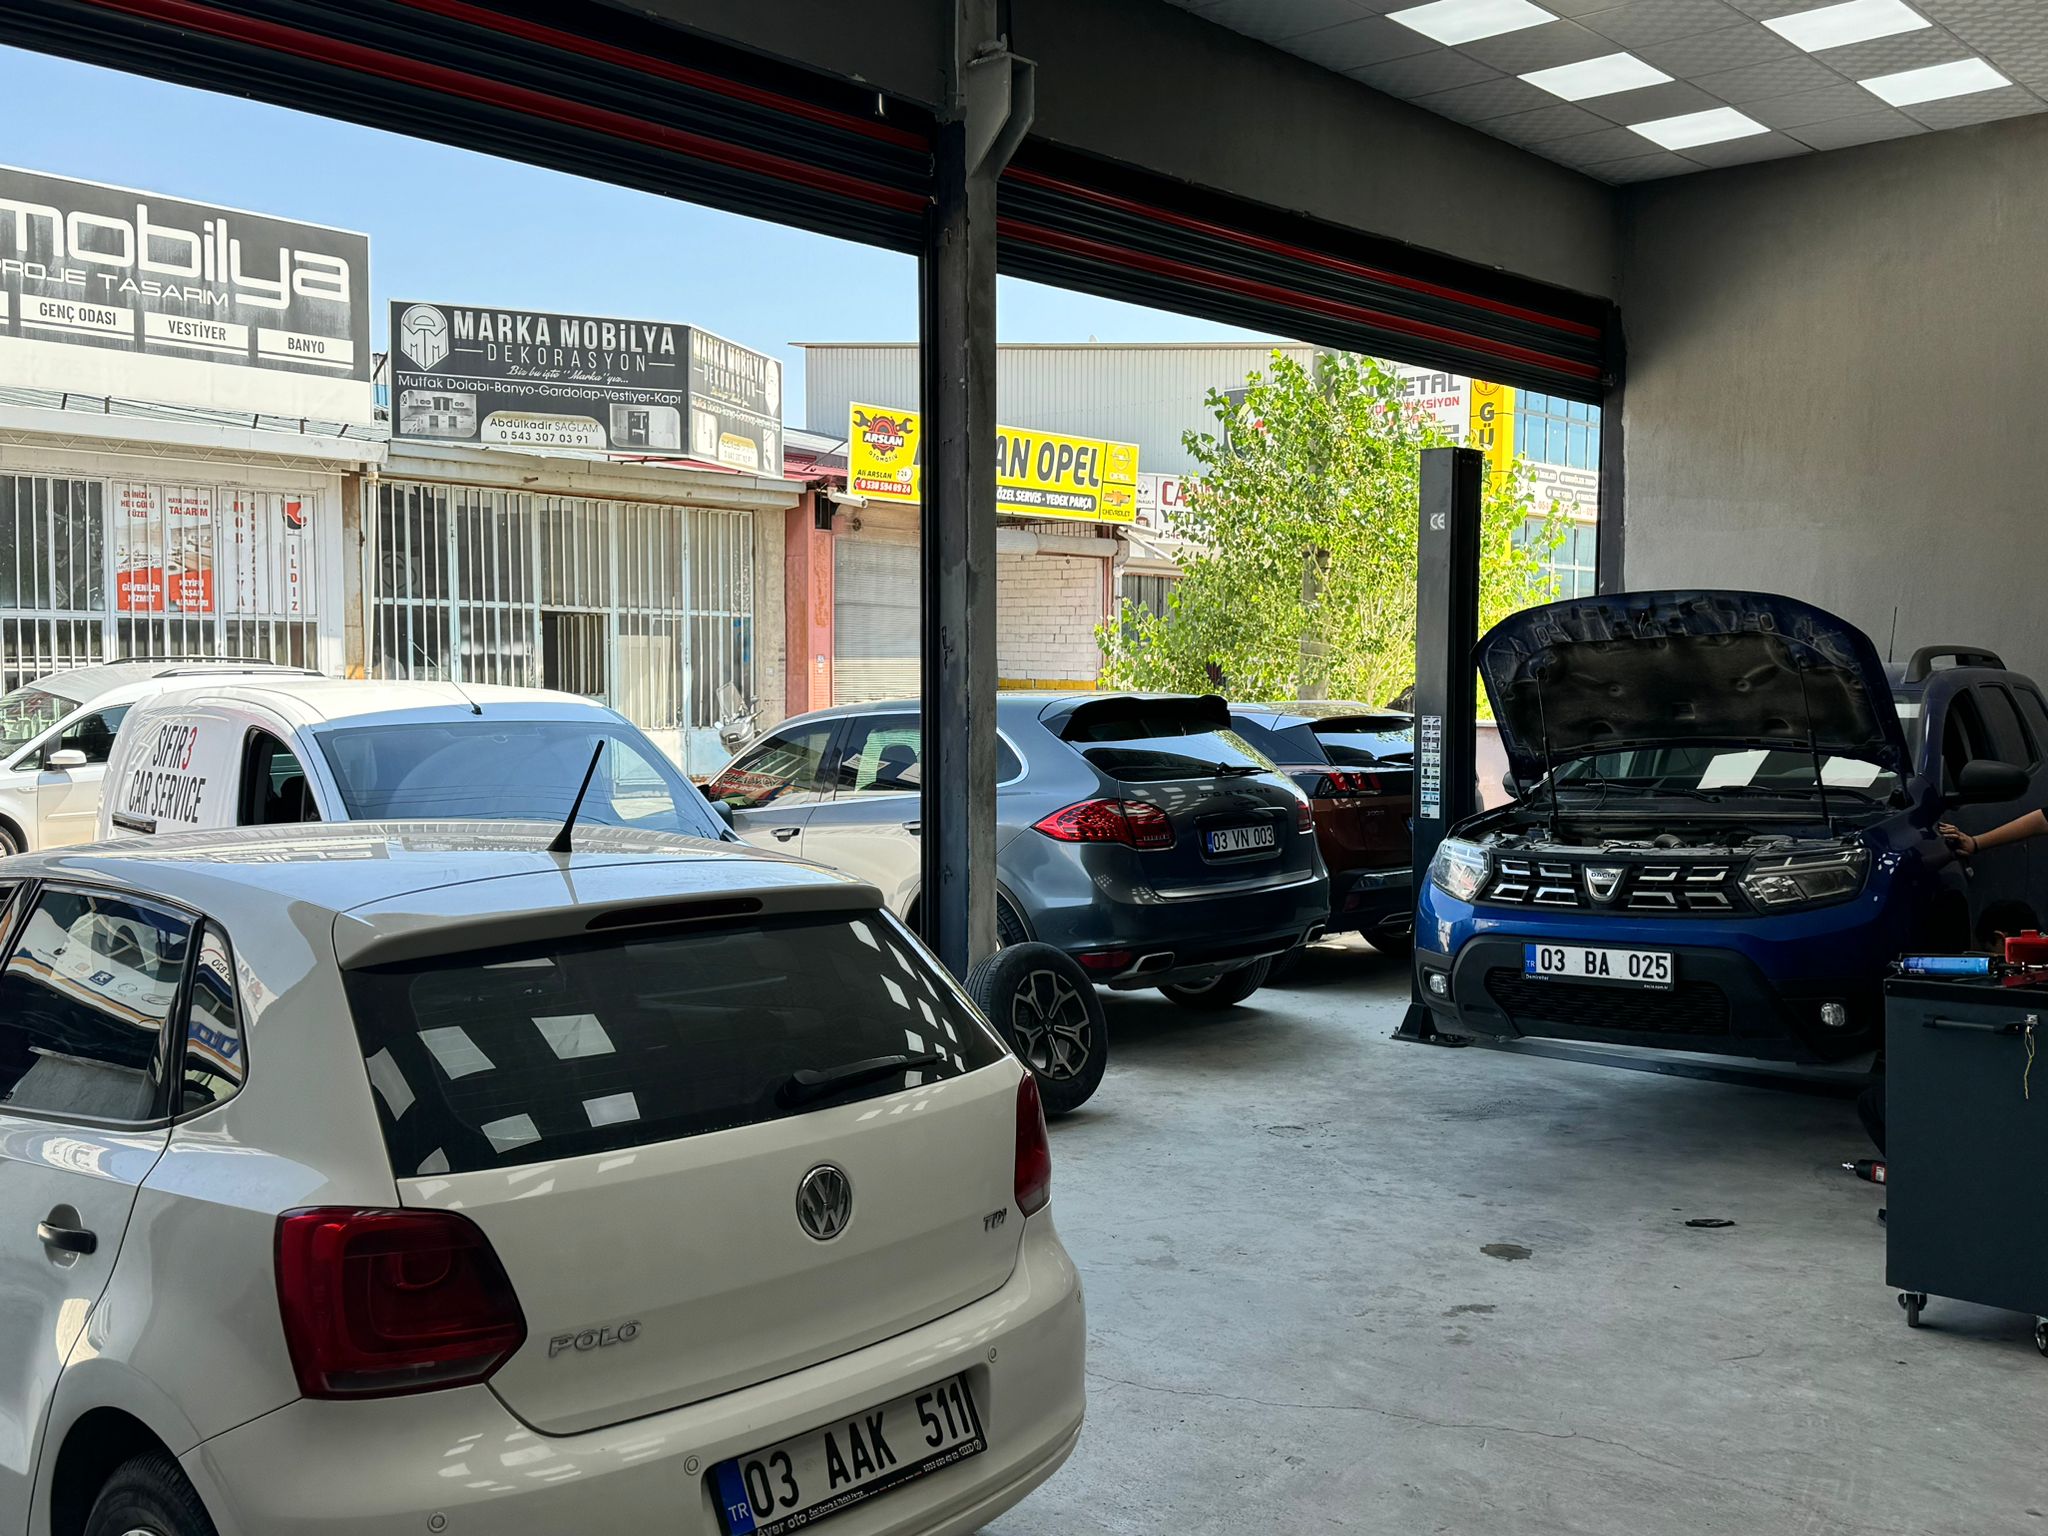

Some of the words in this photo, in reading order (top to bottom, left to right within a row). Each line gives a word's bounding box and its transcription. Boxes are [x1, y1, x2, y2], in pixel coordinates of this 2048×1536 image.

[0, 198, 350, 309] mobilya
[0, 258, 86, 286] ROJE
[97, 272, 228, 307] TASARIM
[39, 302, 75, 323] GENÇ
[78, 307, 117, 326] ODASI
[168, 319, 226, 341] VESTİYER
[453, 309, 551, 346] MARKA
[287, 336, 325, 354] BANYO
[487, 342, 645, 373] DEKORASYON
[398, 375, 443, 389] Mutfak
[507, 365, 527, 377] Biz
[529, 366, 542, 377] bu
[1396, 373, 1460, 397] ETAL
[490, 417, 552, 431] Abdülkadir
[555, 420, 599, 433] SAĞLAM
[501, 430, 507, 439] 0
[511, 431, 531, 441] 543
[535, 432, 555, 442] 307
[560, 434, 572, 443] 03
[576, 435, 588, 444] 91
[864, 432, 903, 446] ARSLAN
[1037, 441, 1099, 487] OPEL
[168, 506, 208, 517] TASARM
[1016, 491, 1042, 504] SERVİS
[1046, 494, 1070, 506] YEDEK
[1070, 496, 1092, 510] PARÇA
[1102, 508, 1131, 518] CHEVROLET
[129, 769, 153, 815] CAR
[151, 772, 207, 824] SERVICE
[1213, 831, 1228, 851] 03
[1232, 828, 1249, 848] VN
[1253, 826, 1274, 846] 003
[1526, 959, 1536, 967] TR
[1541, 948, 1565, 972] 03
[1585, 950, 1610, 976] BA
[1629, 953, 1668, 980] 025
[548, 1319, 643, 1359] POLO
[744, 1450, 799, 1518] 03
[824, 1411, 897, 1490] AAK
[915, 1383, 971, 1448] 511
[728, 1502, 750, 1523] TR
[787, 1513, 807, 1528] oto
